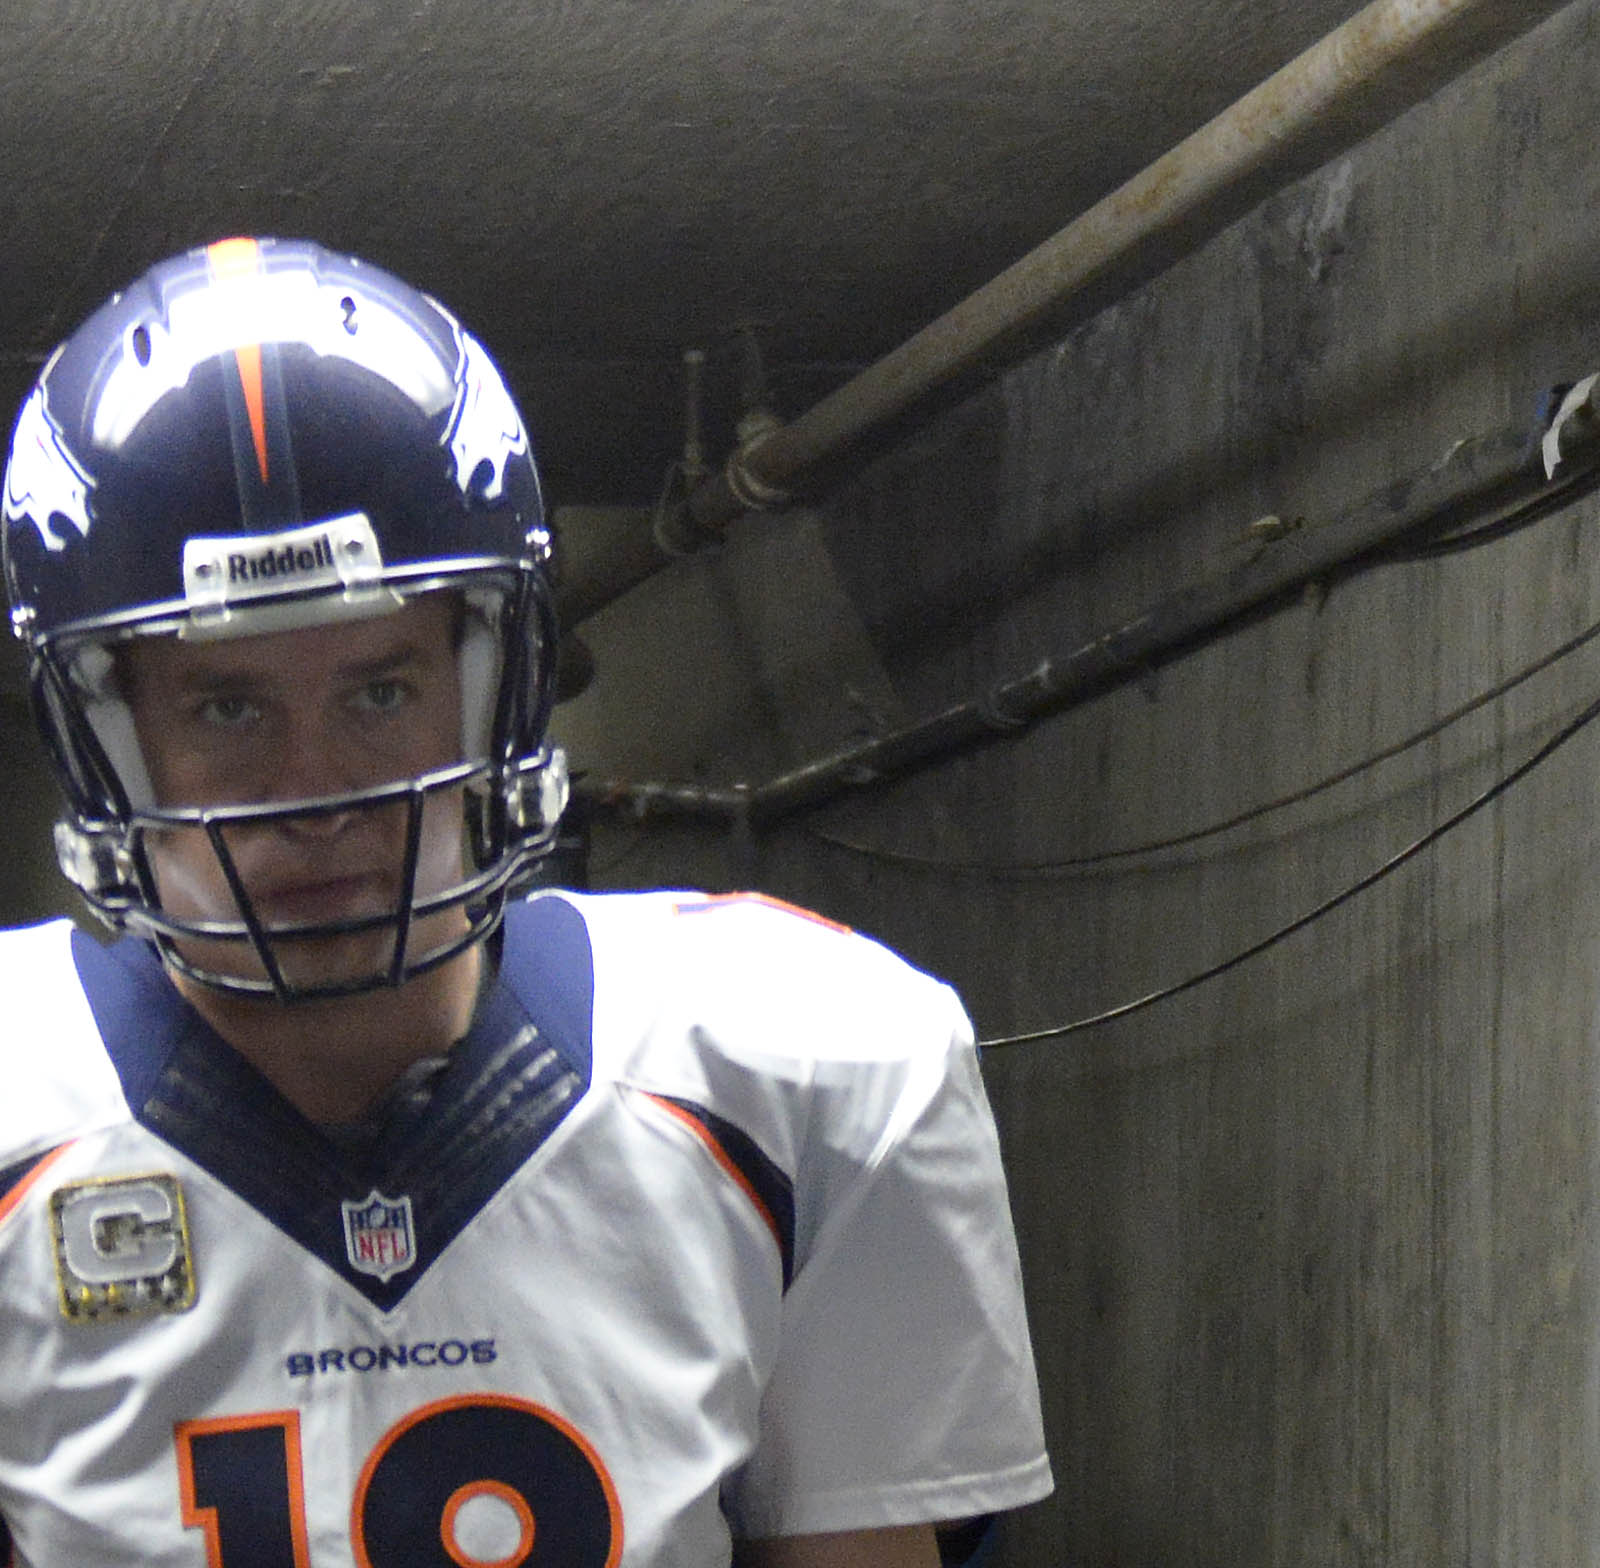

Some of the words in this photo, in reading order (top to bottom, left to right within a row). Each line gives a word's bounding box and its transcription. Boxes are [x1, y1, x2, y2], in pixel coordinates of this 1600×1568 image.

[228, 532, 334, 582] Riddell
[62, 1182, 176, 1284] C
[358, 1230, 406, 1264] NFL
[286, 1338, 498, 1378] BRONCOS
